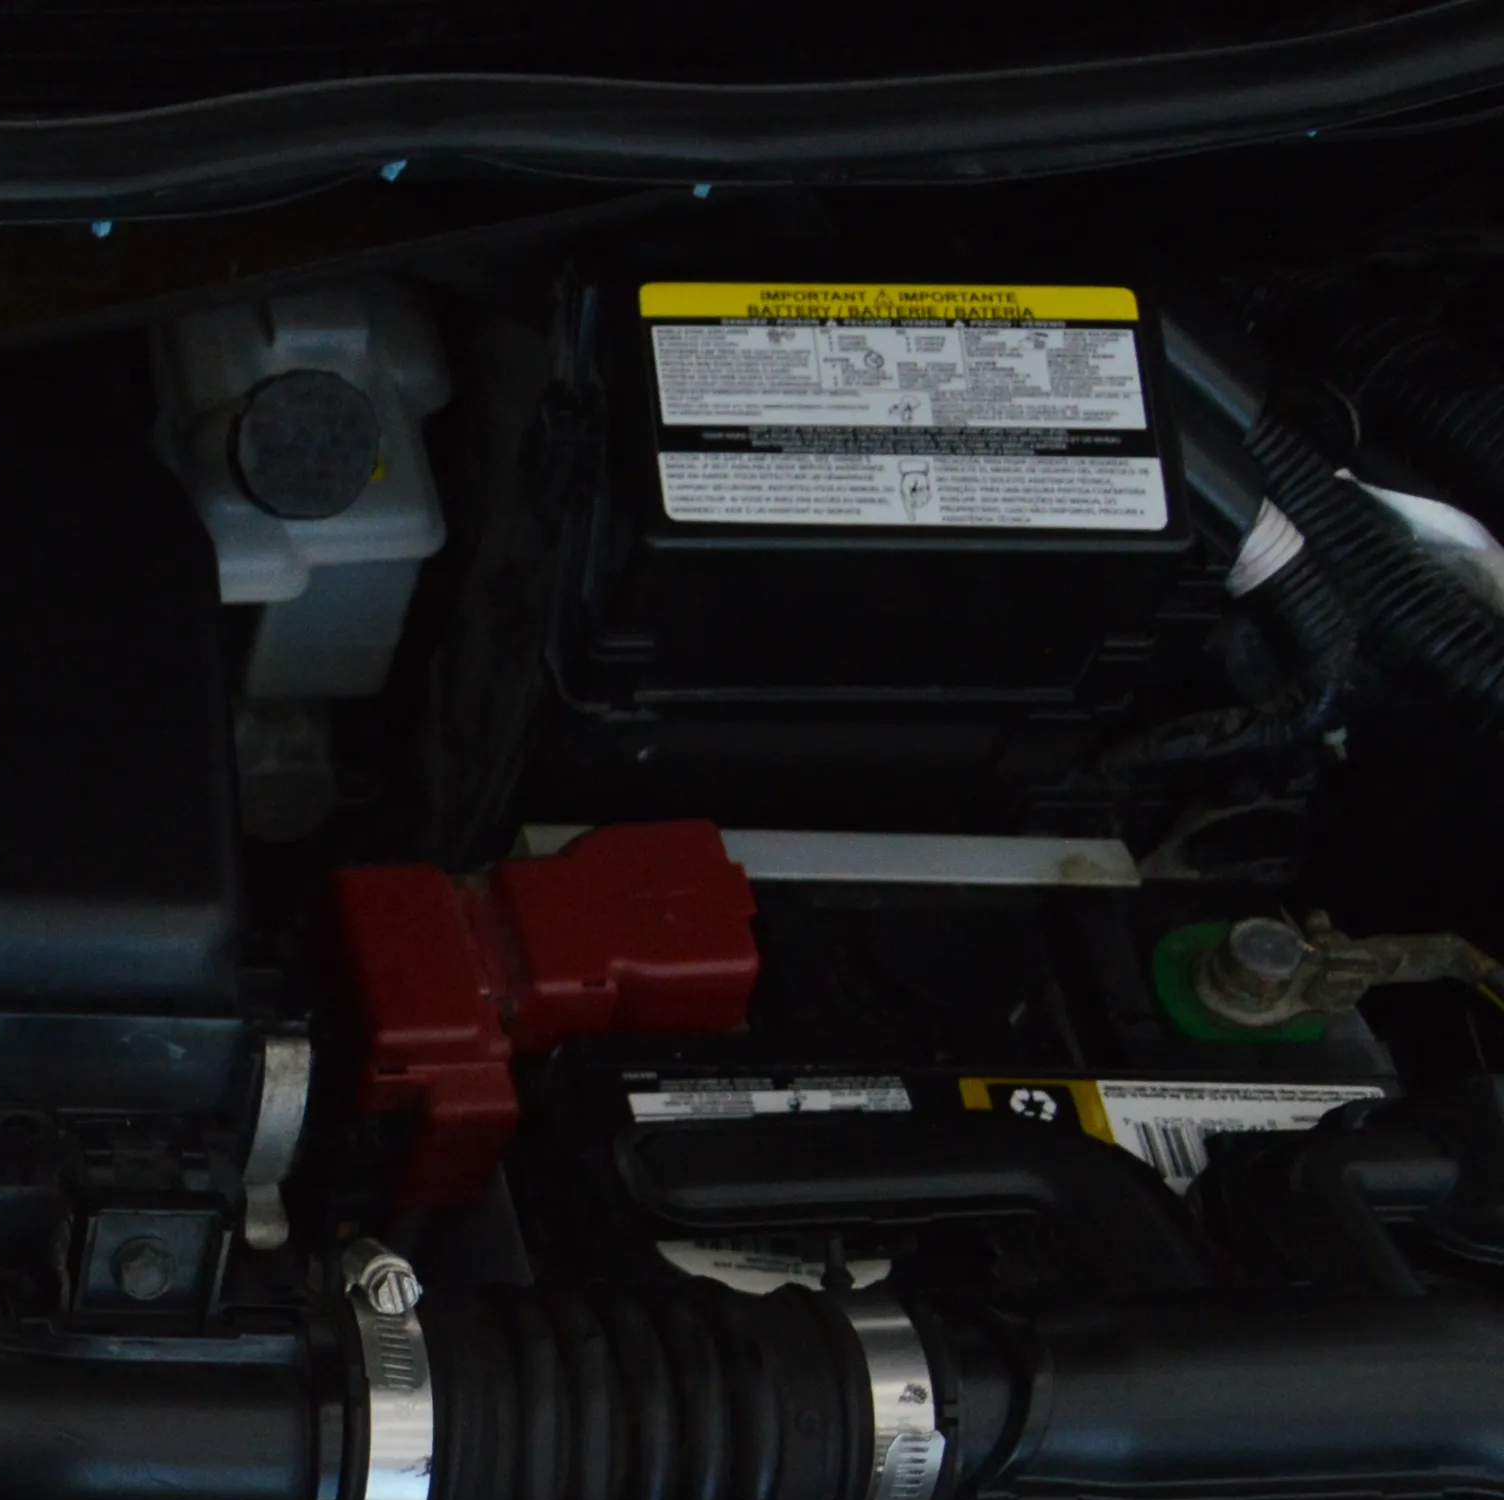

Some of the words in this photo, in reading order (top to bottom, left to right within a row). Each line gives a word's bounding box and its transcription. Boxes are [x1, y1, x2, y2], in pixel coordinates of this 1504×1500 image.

[759, 290, 865, 301] IMPORTANT
[899, 291, 1017, 302] IMPORTANTE
[747, 305, 830, 317] BATTERY
